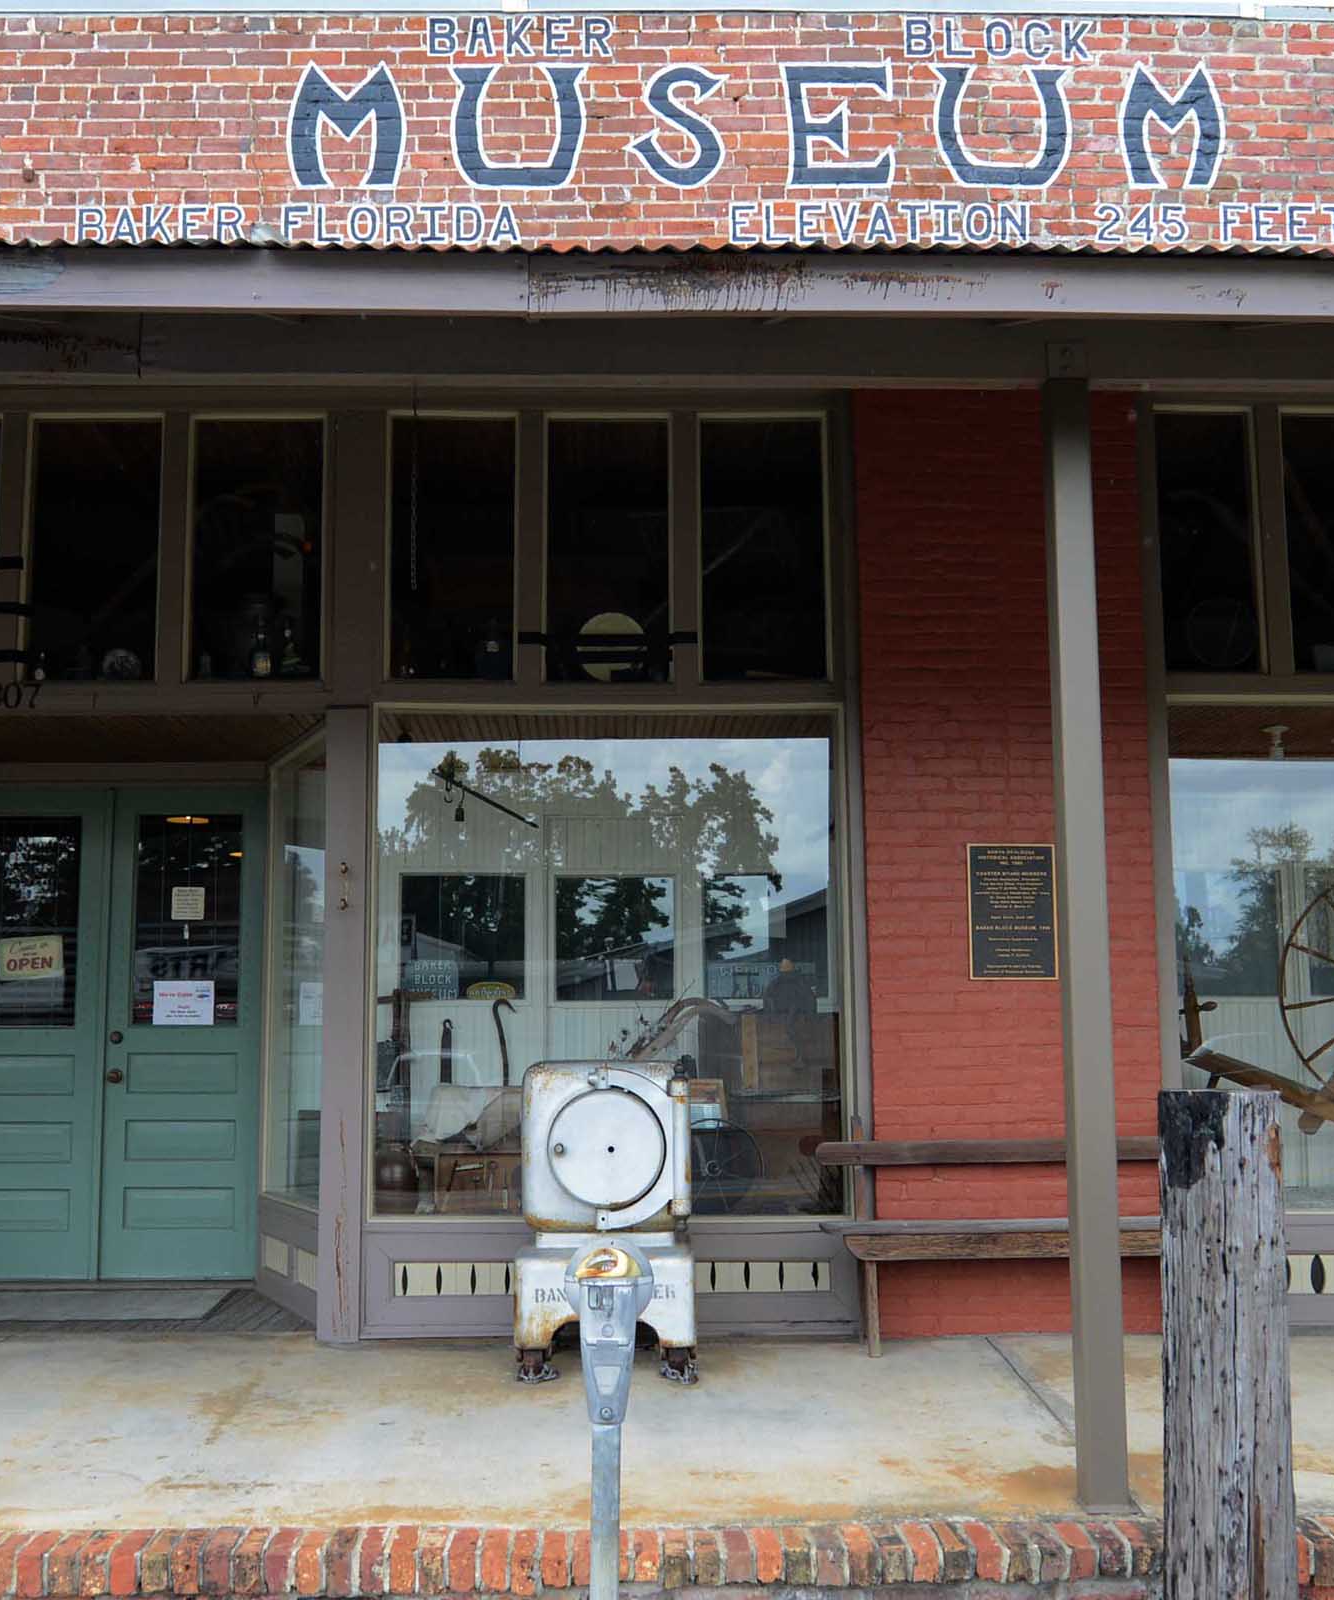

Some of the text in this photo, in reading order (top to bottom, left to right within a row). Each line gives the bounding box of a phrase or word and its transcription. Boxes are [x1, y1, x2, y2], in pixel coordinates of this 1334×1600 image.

[427, 15, 1093, 60] BAKER BLOCK
[285, 60, 1226, 190] MUSEUM
[76, 204, 522, 244] BAKER FLORIDA
[728, 202, 1031, 244] ELEVATION
[1094, 204, 1186, 244] 245
[6, 956, 53, 971] OPEN
[414, 974, 452, 985] BLOCK
[535, 1287, 569, 1303] BAN
